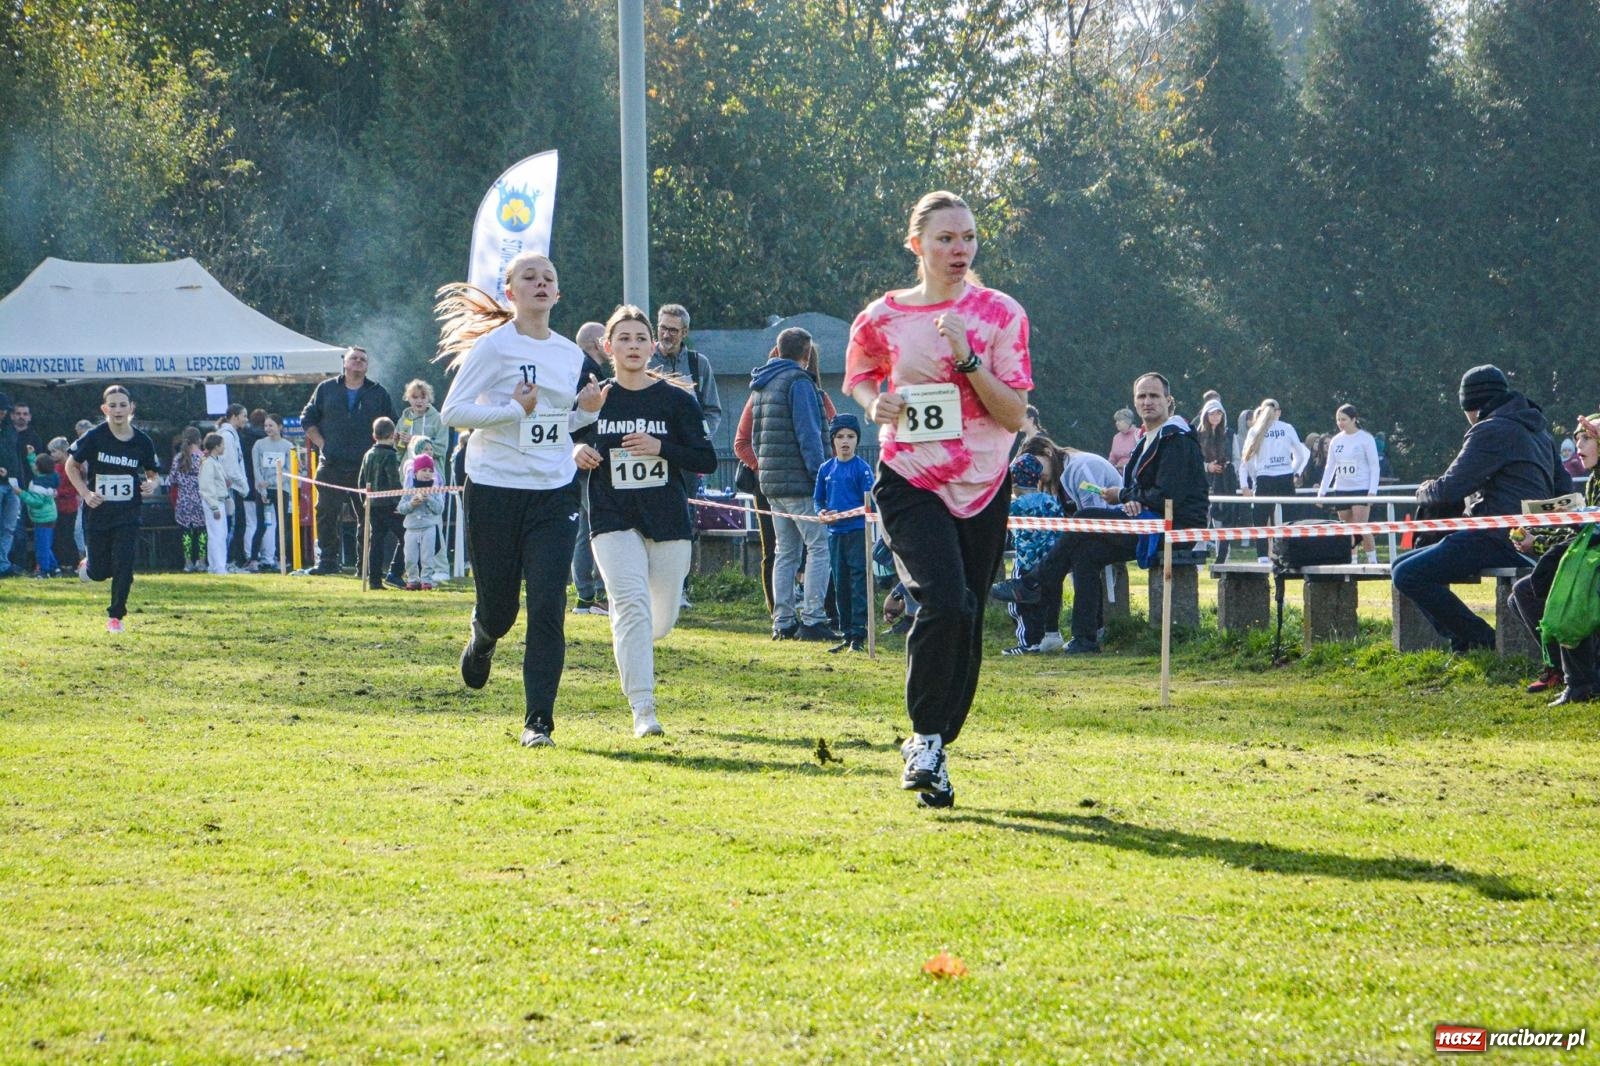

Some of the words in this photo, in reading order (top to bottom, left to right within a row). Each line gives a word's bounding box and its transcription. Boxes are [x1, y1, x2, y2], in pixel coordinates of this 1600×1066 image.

[96, 357, 145, 372] AKTYWNI
[155, 357, 176, 371] DLA
[186, 356, 240, 371] LEPSZEGO
[251, 355, 285, 370] JUTRA
[906, 404, 944, 432] 88
[531, 423, 559, 444] 94
[615, 461, 665, 481] 104
[1337, 465, 1356, 474] 110
[98, 483, 132, 496] 113
